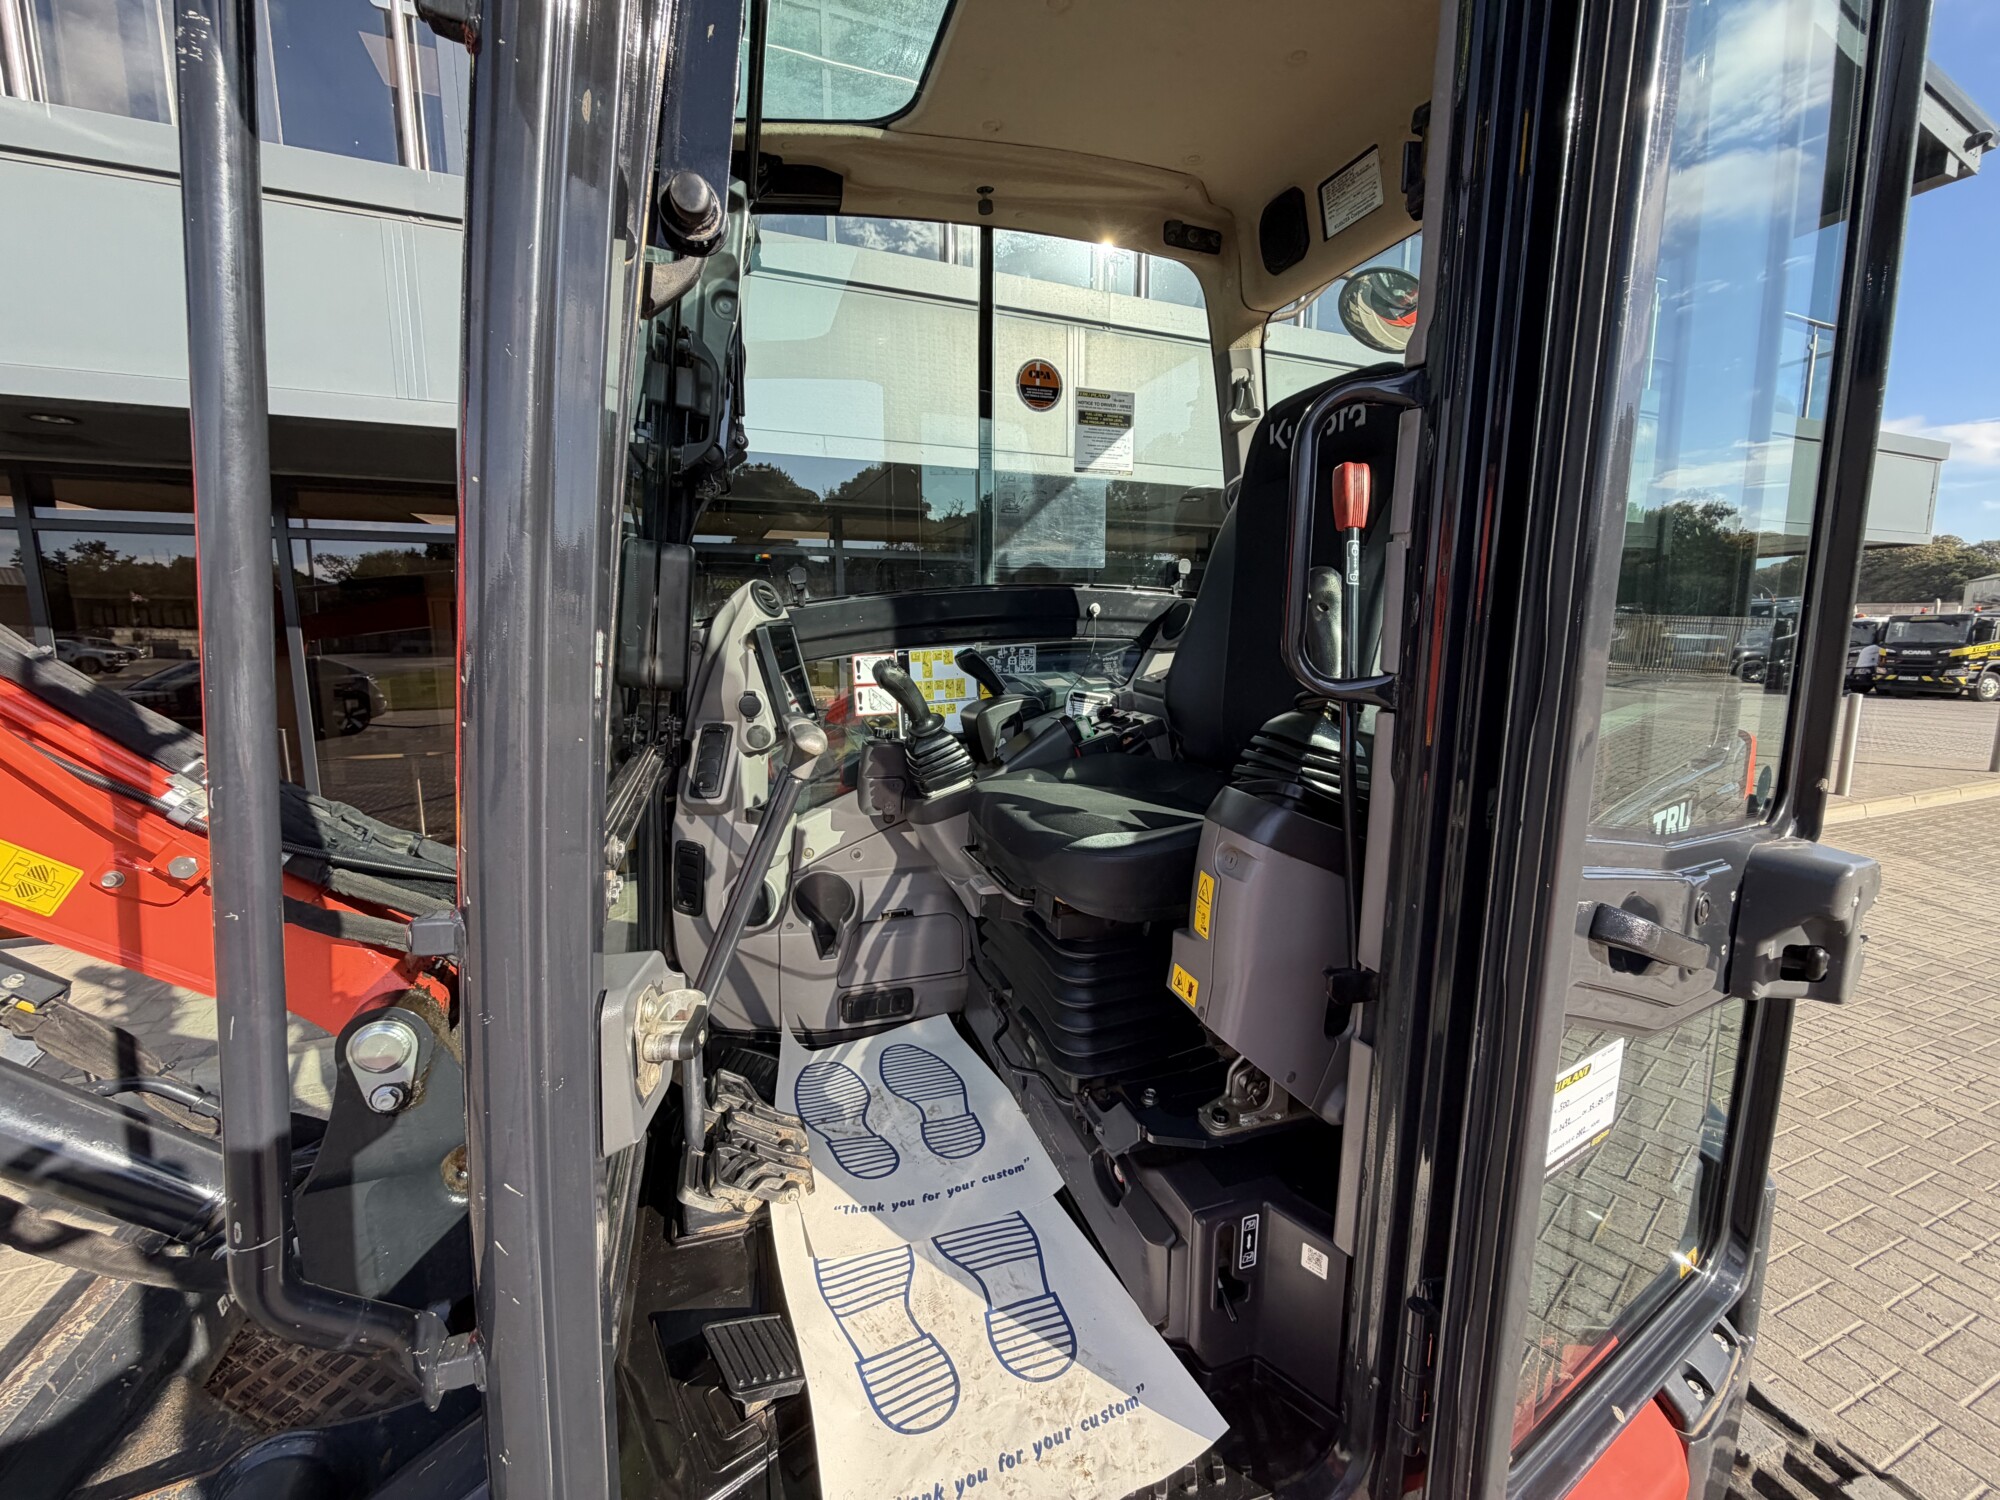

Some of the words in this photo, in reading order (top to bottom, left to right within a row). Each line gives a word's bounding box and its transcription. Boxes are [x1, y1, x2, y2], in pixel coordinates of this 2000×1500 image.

[1028, 370, 1051, 380] CPA
[891, 1199, 915, 1213] you
[922, 1190, 940, 1203] for
[946, 1179, 976, 1199] your
[954, 1467, 988, 1496] you
[998, 1448, 1024, 1473] for
[1032, 1425, 1072, 1462] your
